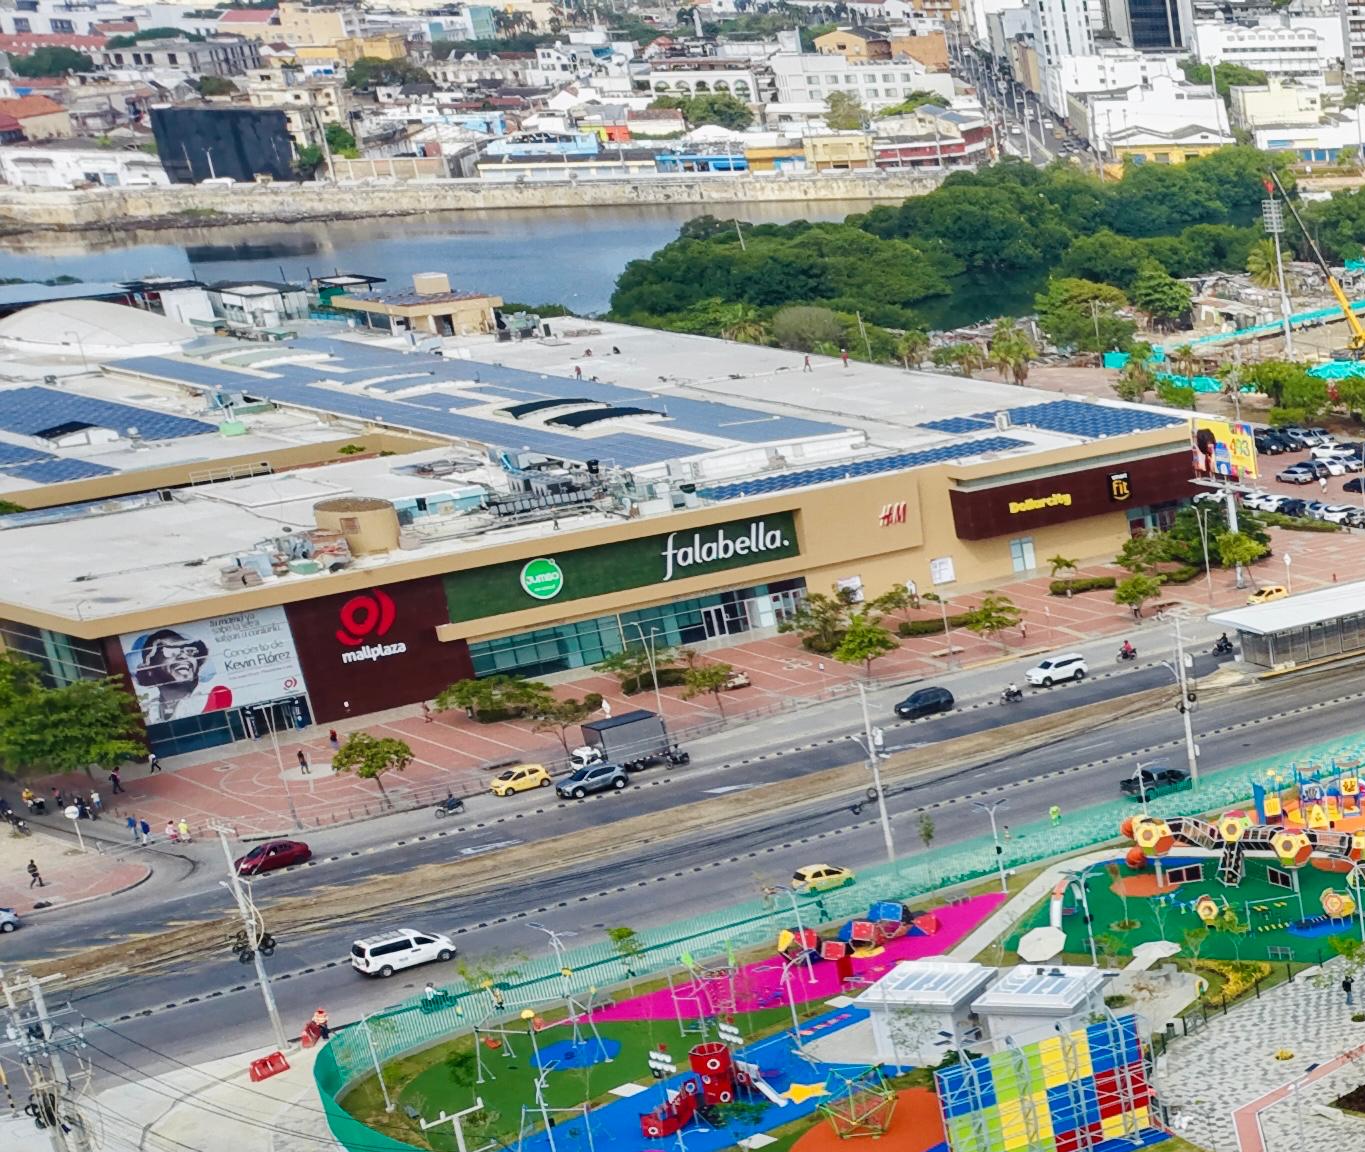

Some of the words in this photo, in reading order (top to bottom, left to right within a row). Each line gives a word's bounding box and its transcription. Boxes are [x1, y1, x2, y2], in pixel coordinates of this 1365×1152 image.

[224, 656, 256, 671] Kevin
[256, 650, 290, 666] Flórez
[341, 642, 407, 663] mallplaza
